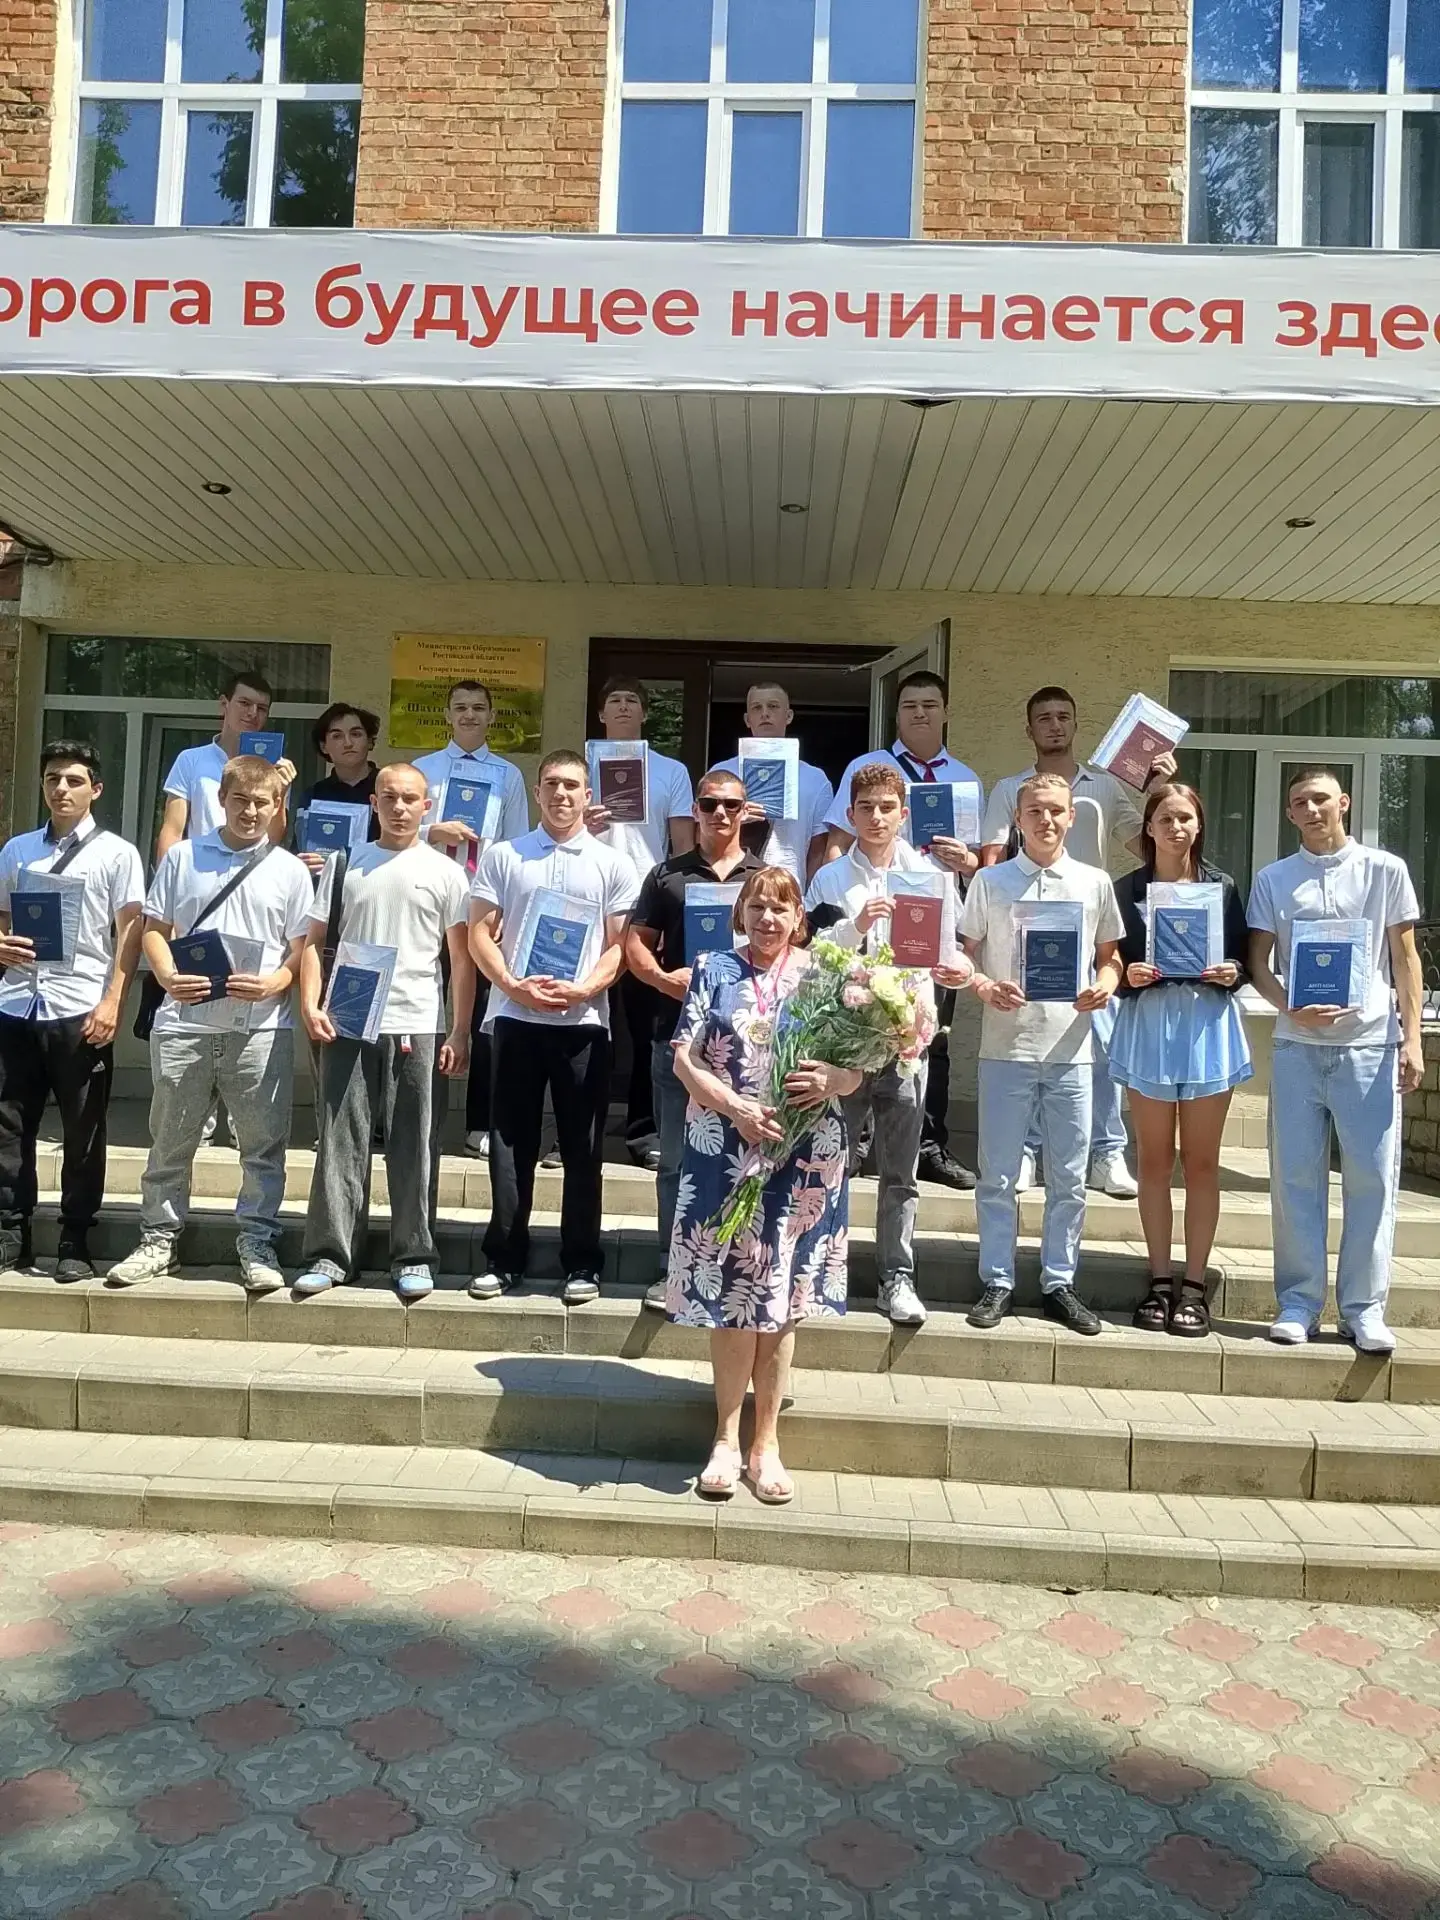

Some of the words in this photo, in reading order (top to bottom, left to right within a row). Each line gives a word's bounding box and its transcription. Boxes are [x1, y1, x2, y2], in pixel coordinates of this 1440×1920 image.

[243, 281, 285, 327] в
[315, 263, 698, 349] будущее
[732, 291, 1194, 345] начинается
[1276, 301, 1440, 358] зде
